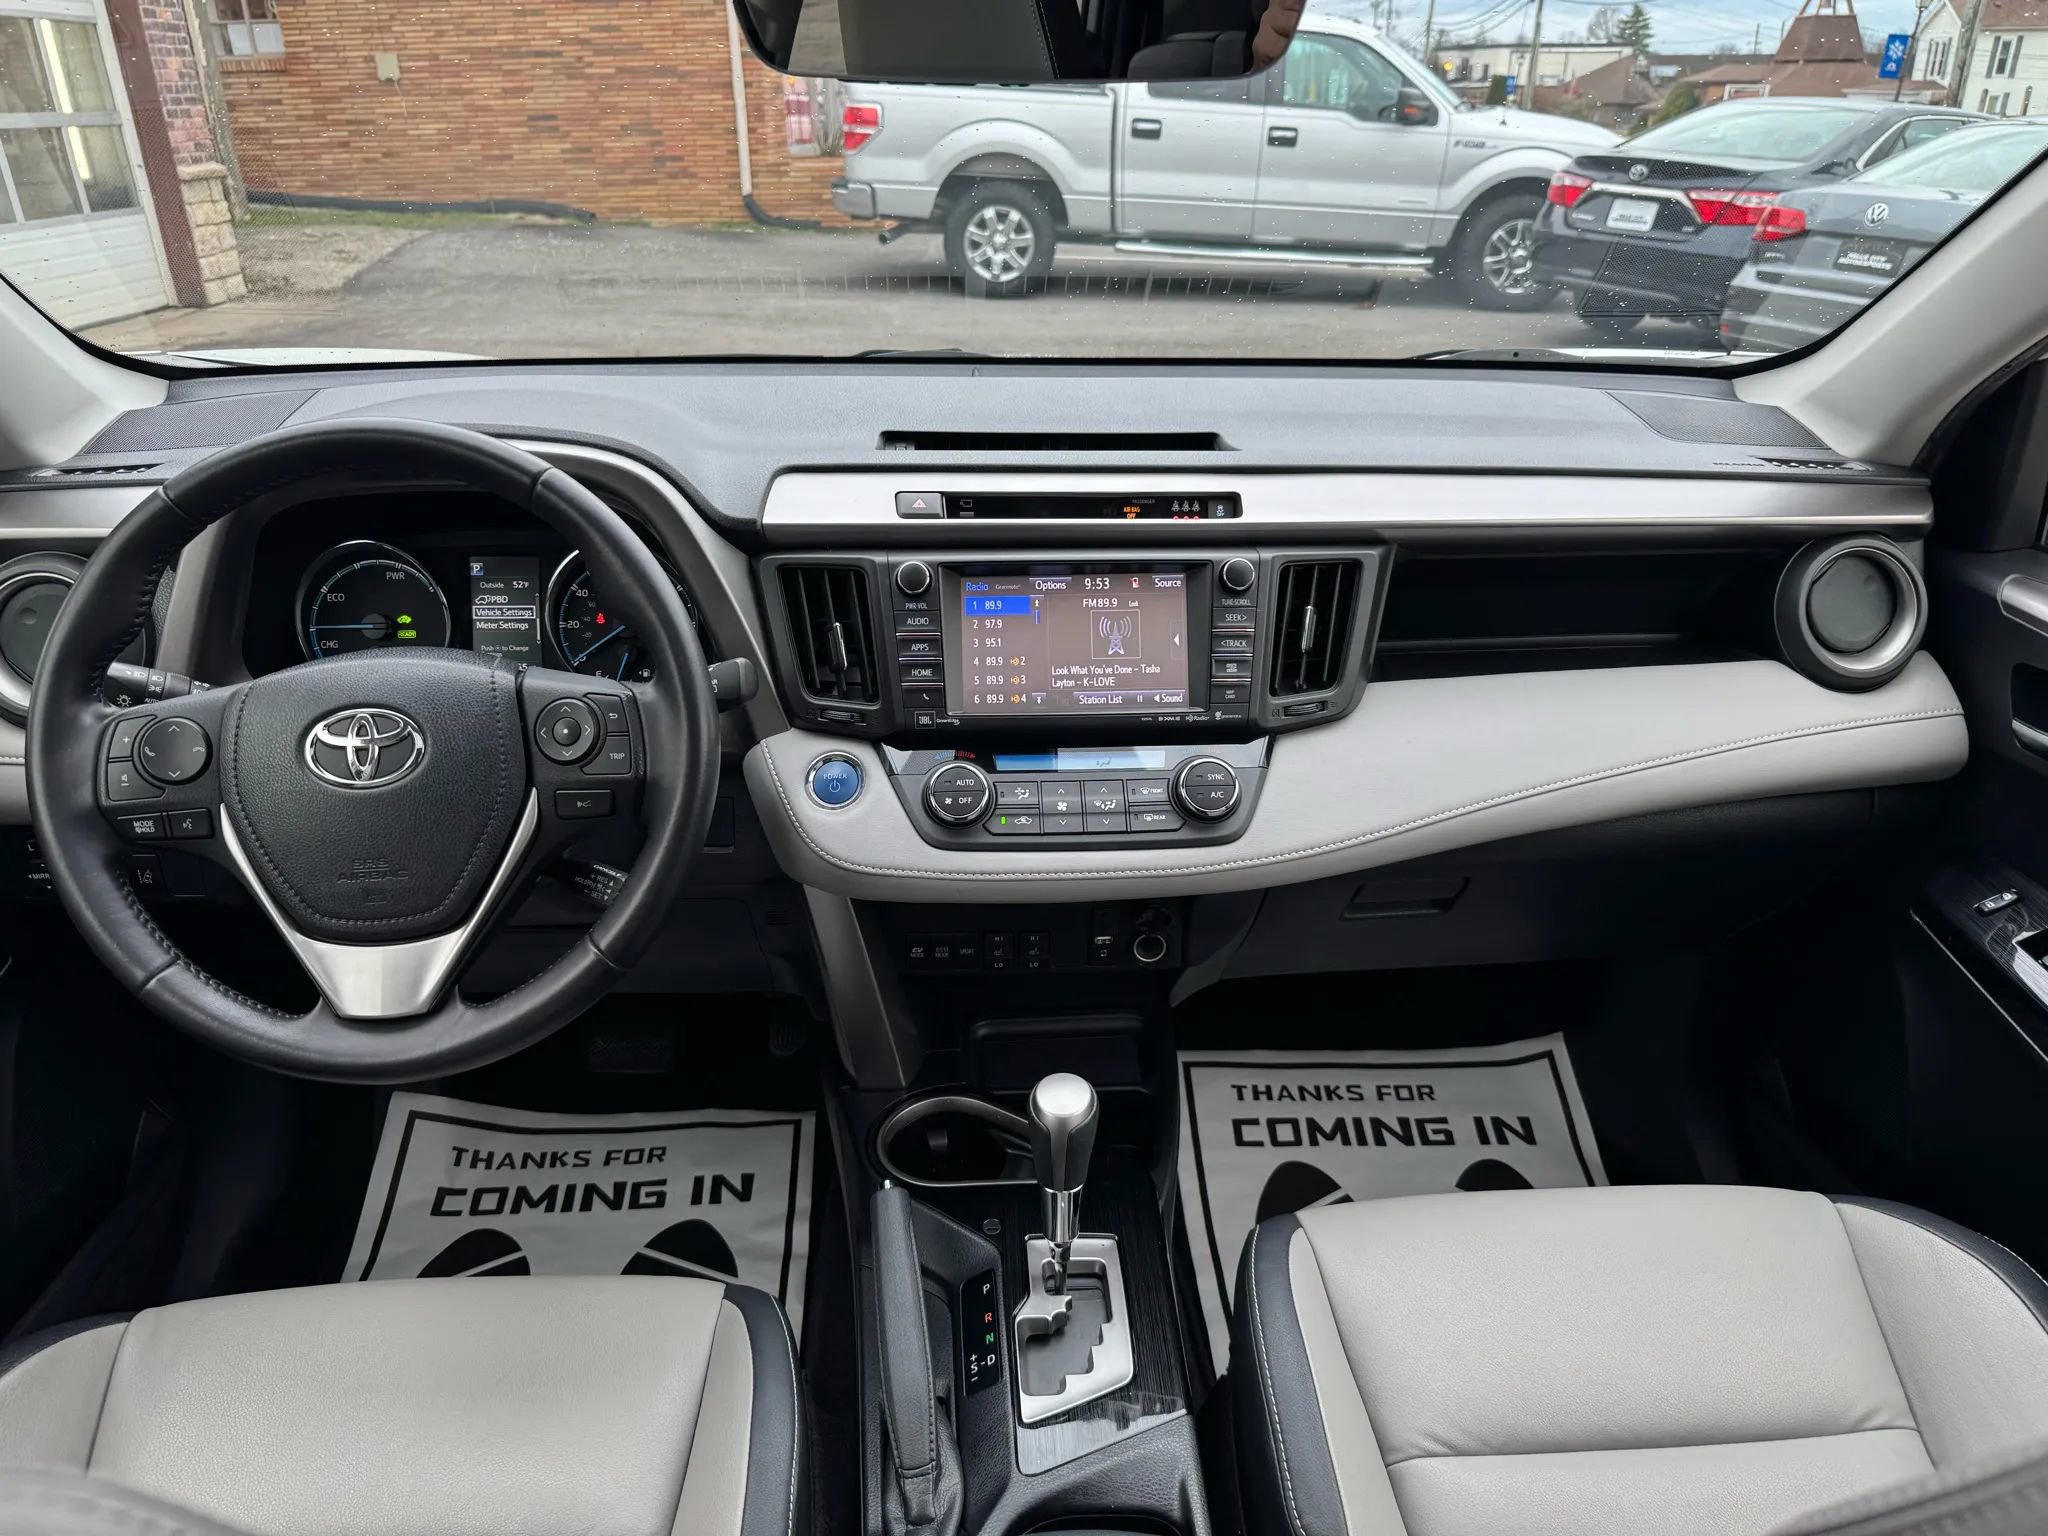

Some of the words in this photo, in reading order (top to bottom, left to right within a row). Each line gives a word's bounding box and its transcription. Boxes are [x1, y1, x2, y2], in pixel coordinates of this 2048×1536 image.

[386, 572, 405, 580] PWR
[966, 582, 988, 591] Radio
[1035, 580, 1067, 591] Options
[1084, 578, 1110, 589] 9:53
[1155, 579, 1182, 587] Source
[327, 593, 345, 602] ECO
[973, 601, 977, 610] 1
[985, 601, 1002, 609] 89.9
[503, 608, 532, 618] Settings
[499, 621, 528, 630] Settings
[973, 620, 978, 628] 2
[985, 620, 1002, 628] 97.9
[320, 640, 338, 648] CHG
[973, 639, 979, 647] 3
[986, 638, 1001, 647] 95.1
[974, 658, 979, 666] 4
[986, 657, 1003, 666] 89.9
[1052, 666, 1069, 675] Look
[1070, 666, 1088, 675] What
[1089, 665, 1113, 674] You've
[1114, 665, 1132, 674] Done
[1140, 664, 1160, 673] Tasha
[974, 676, 979, 685] 5
[986, 676, 1003, 684] 89.9
[1052, 678, 1075, 688] Layton
[1083, 678, 1115, 686] K-LOVE
[974, 695, 980, 704] 6
[986, 694, 1004, 703] 89.9
[1079, 695, 1106, 704] Station
[1108, 695, 1122, 704] List
[1161, 694, 1183, 702] Sound
[919, 716, 932, 724] JBL
[352, 858, 389, 870] SRS
[336, 872, 408, 883] AIRBAG
[1230, 1084, 1364, 1102] THANKS
[1376, 1084, 1436, 1101] FOR
[1232, 1116, 1456, 1148] COMING
[1473, 1116, 1537, 1146] IN
[451, 1146, 592, 1170] THANKS
[602, 1146, 666, 1168] FOR
[430, 1177, 668, 1217] COMING
[690, 1172, 755, 1206] IN
[983, 1284, 990, 1294] P
[985, 1312, 992, 1323] R
[986, 1332, 994, 1344] N
